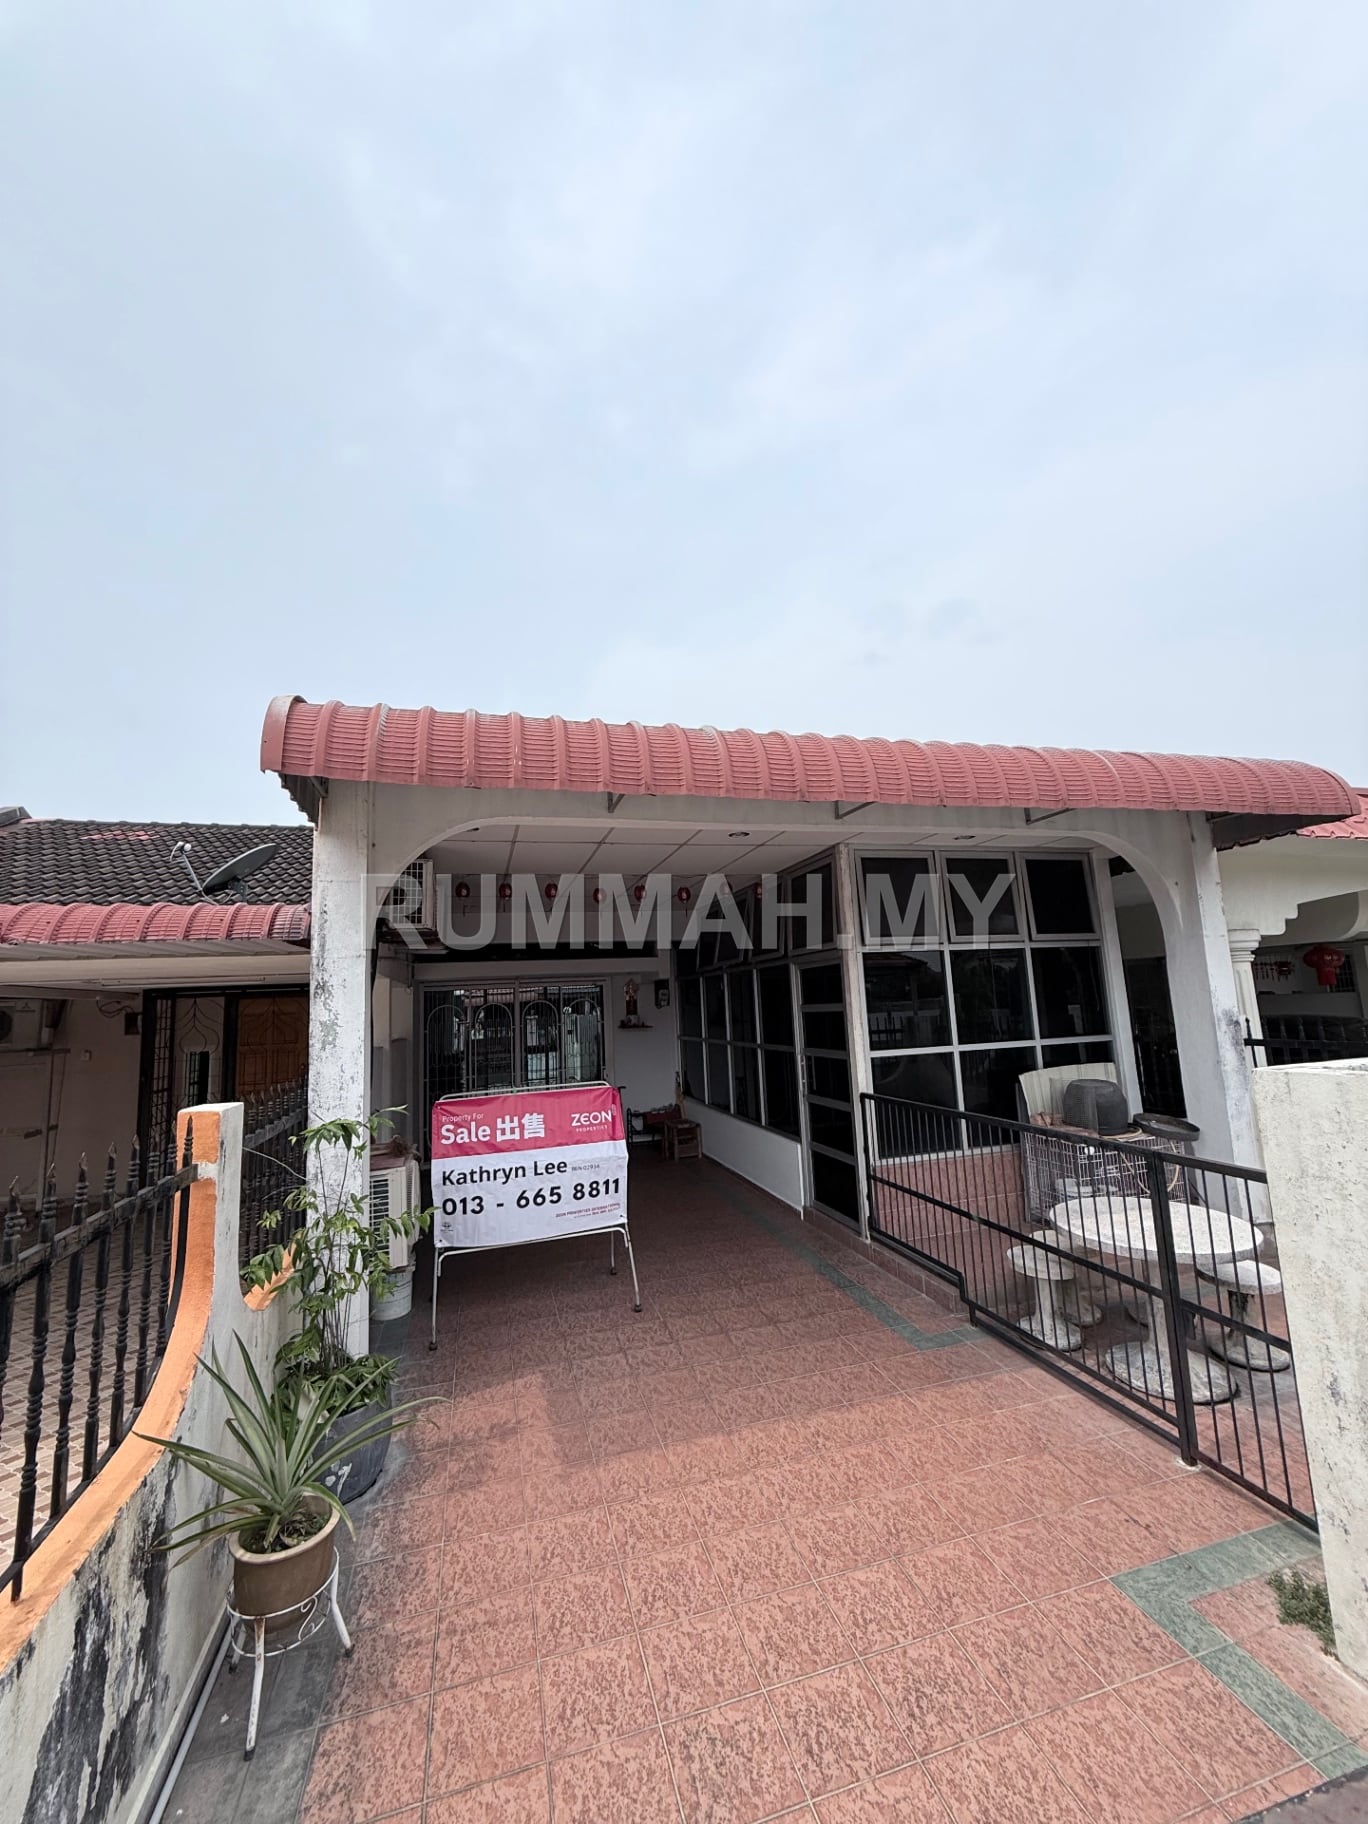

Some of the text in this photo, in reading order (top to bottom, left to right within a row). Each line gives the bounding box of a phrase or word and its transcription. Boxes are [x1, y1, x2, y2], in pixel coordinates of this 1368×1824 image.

[442, 1112, 484, 1124] Property For
[496, 1112, 545, 1143] 出售
[571, 1109, 612, 1127] ZEON
[440, 1121, 491, 1145] Sale
[442, 1163, 526, 1186] Kathryn
[533, 1160, 568, 1177] Lee
[442, 1196, 485, 1216] 013
[516, 1186, 562, 1209] 665
[572, 1178, 620, 1201] 8811
